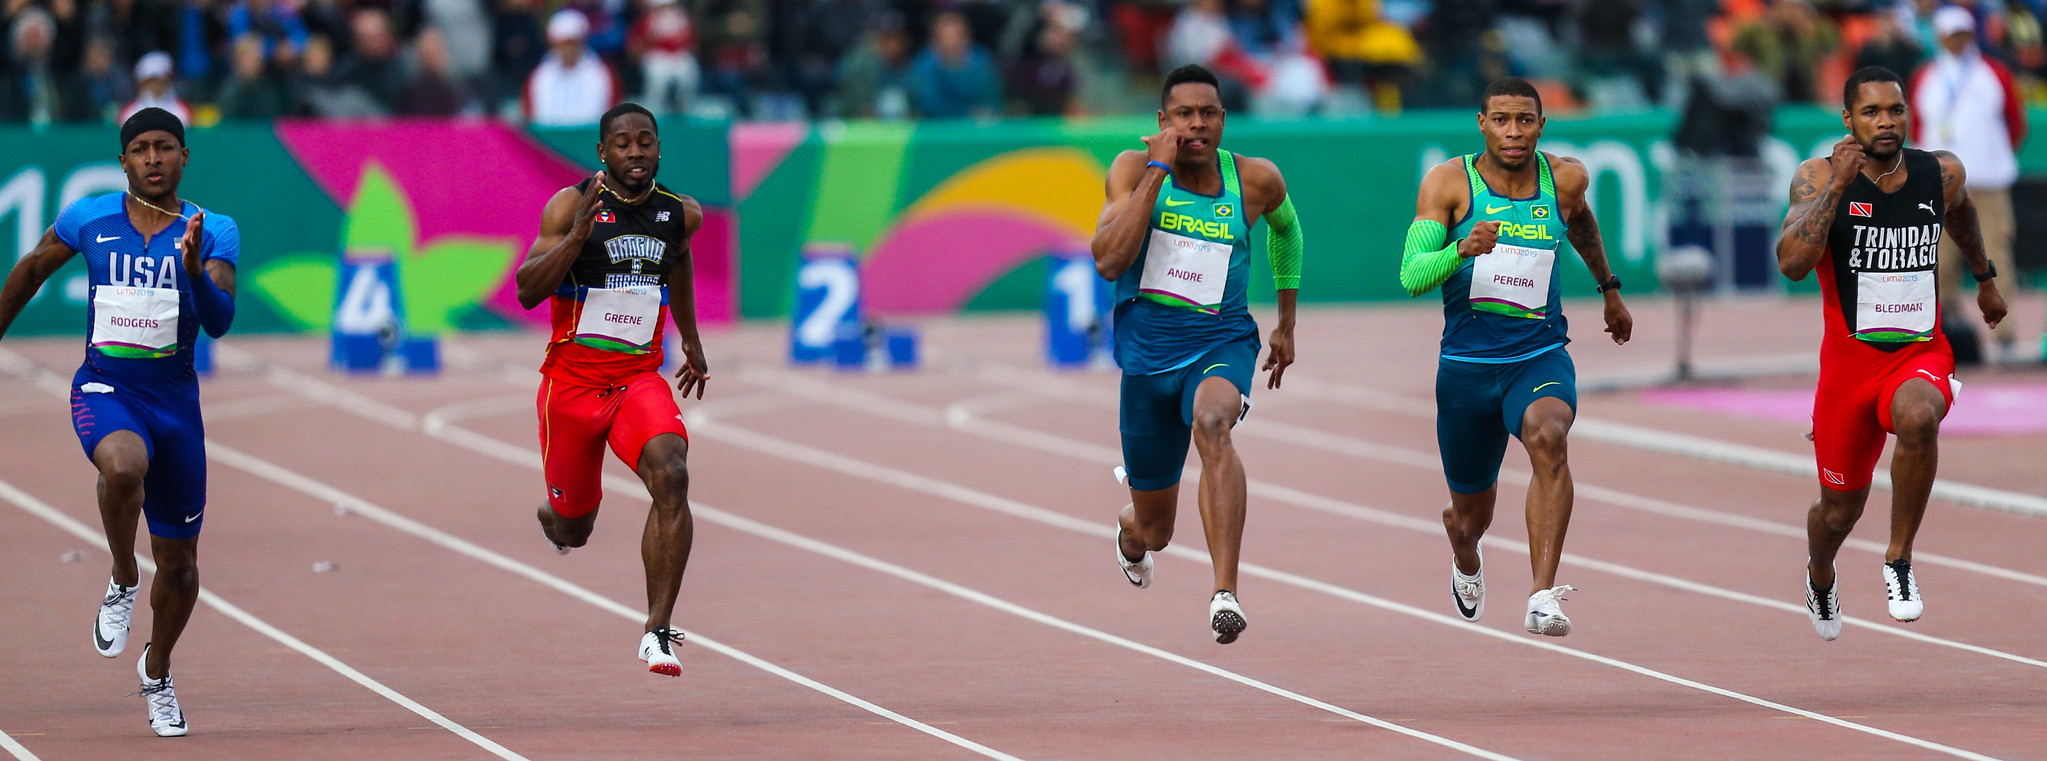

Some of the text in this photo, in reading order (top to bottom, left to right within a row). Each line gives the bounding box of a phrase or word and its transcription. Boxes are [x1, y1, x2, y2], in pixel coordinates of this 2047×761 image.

[1160, 211, 1235, 240] BRASIL
[1497, 220, 1553, 240] RASIL
[1853, 222, 1941, 249] TRINIDAD
[605, 235, 667, 263] ANTIGUA
[1849, 243, 1938, 270] & TOBAGO
[109, 251, 178, 290] USA
[1167, 268, 1204, 283] ANDRE
[1493, 274, 1535, 289] PEREIRA
[339, 263, 394, 334] 4
[799, 259, 859, 347] 2
[1052, 259, 1098, 332] 1
[1874, 302, 1923, 313] BLEDMAN
[110, 315, 159, 329] RODGERS
[604, 312, 643, 326] GREENE
